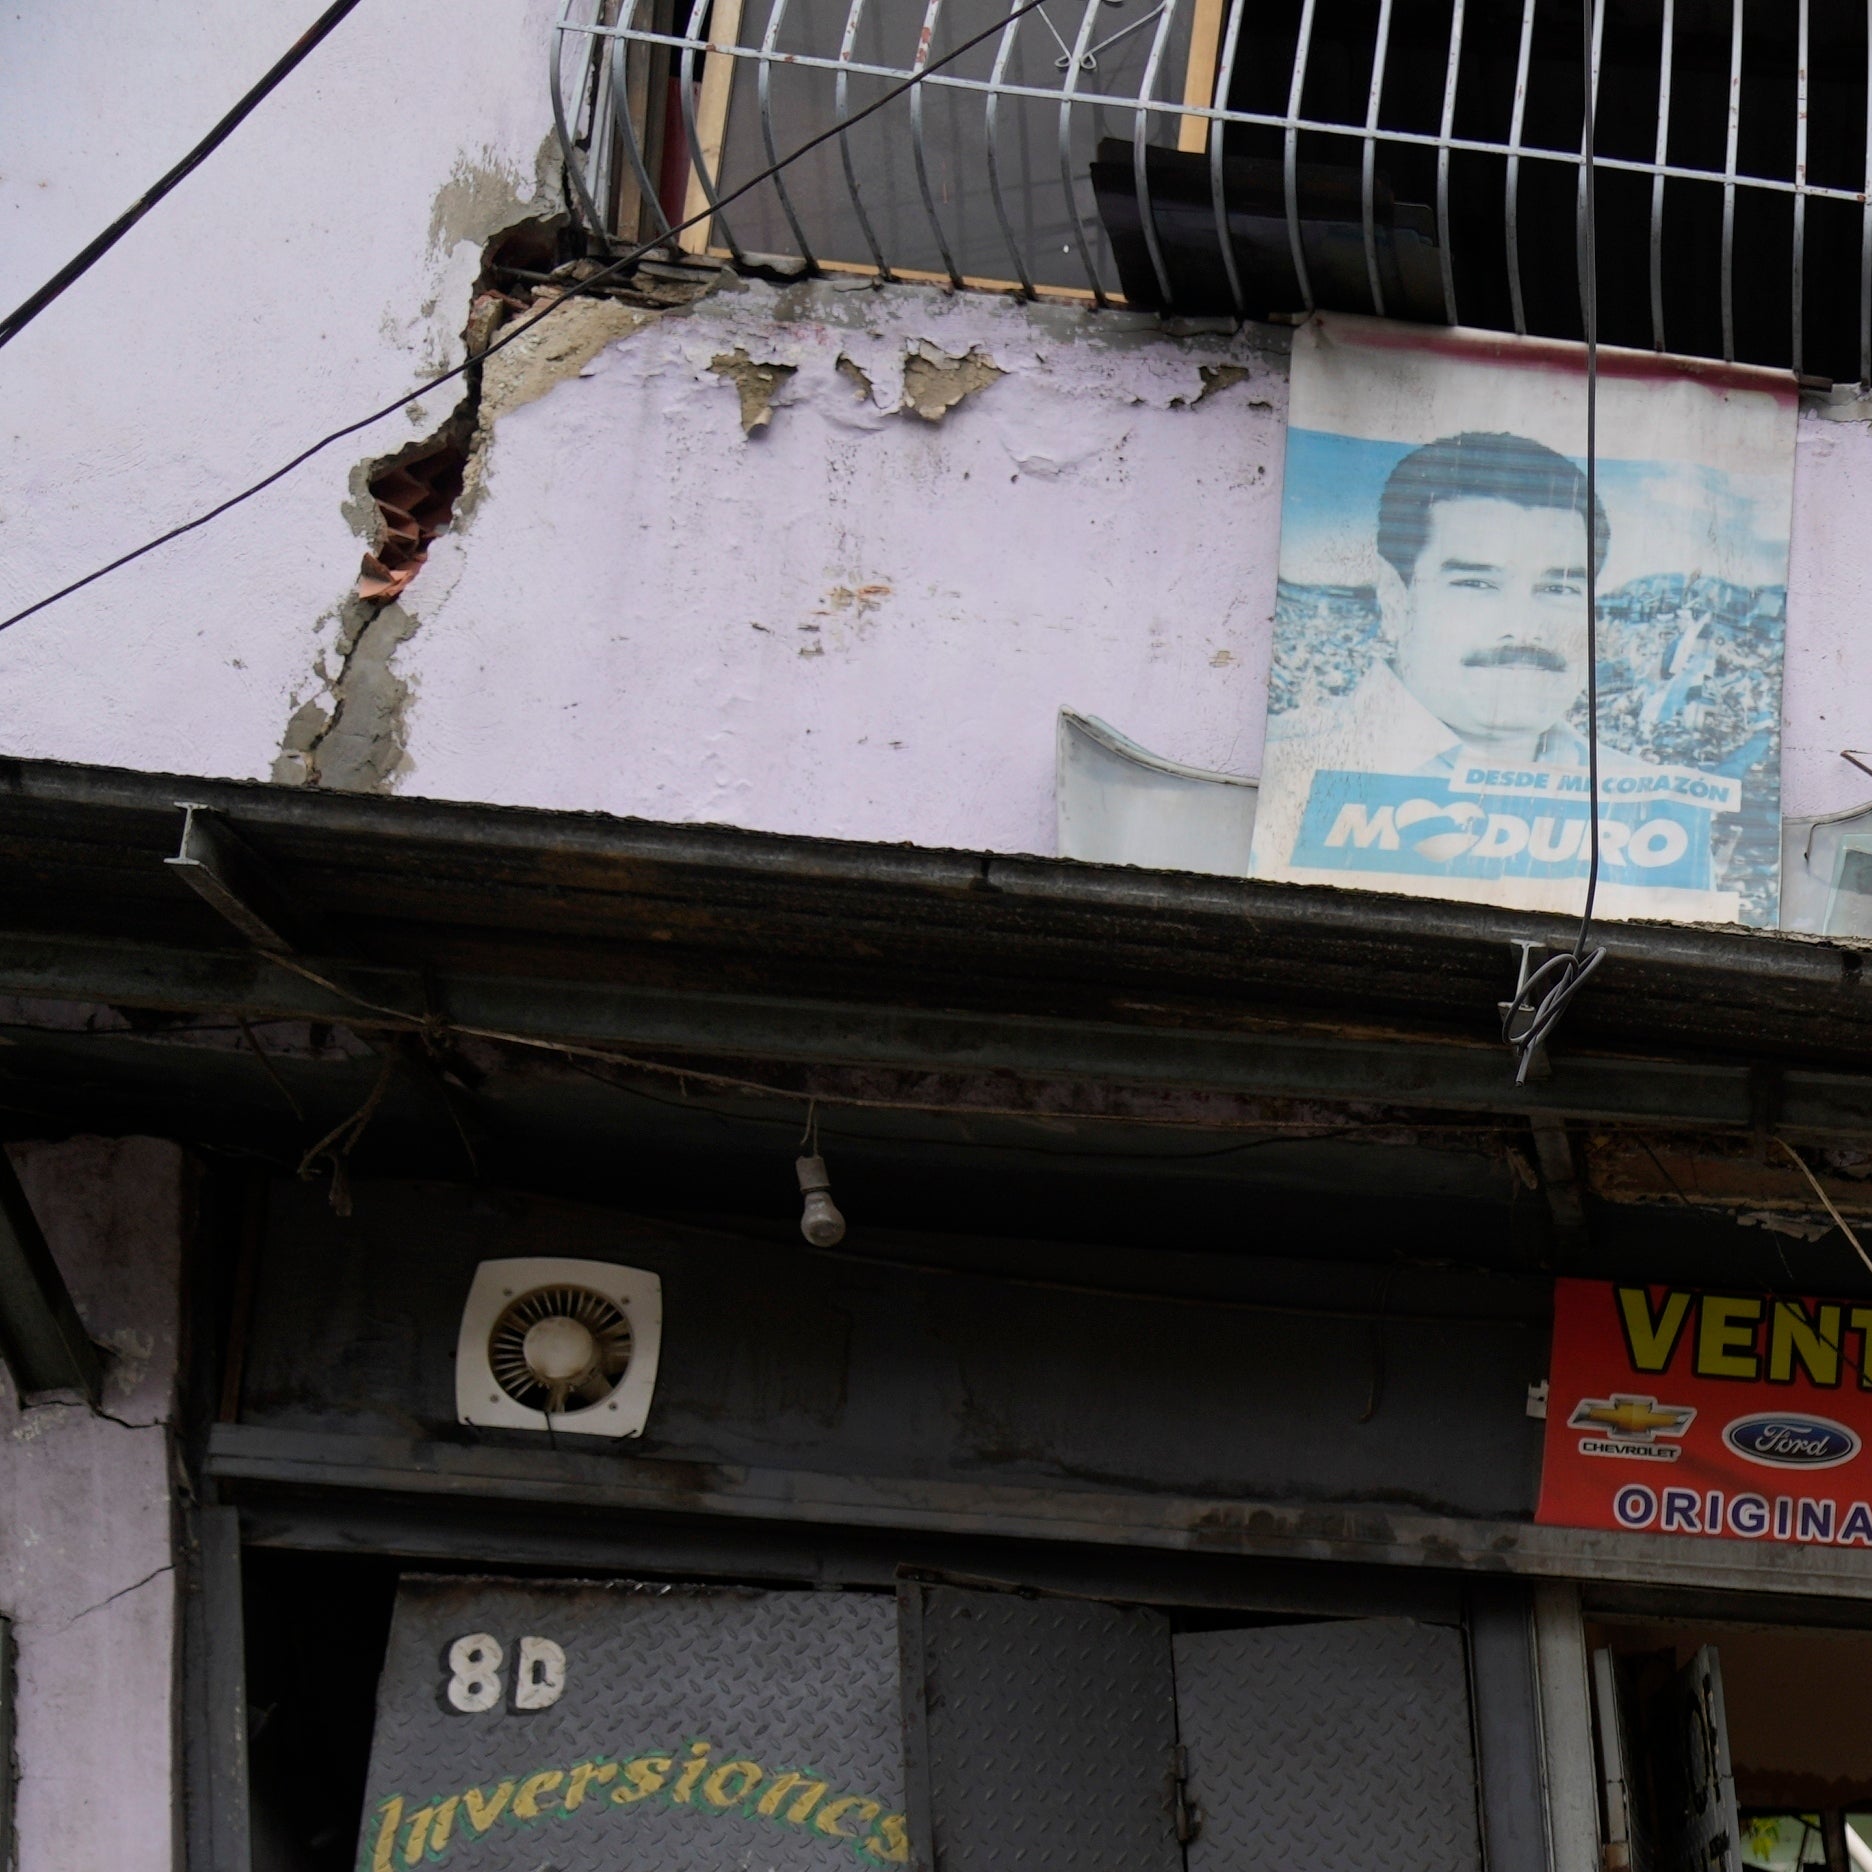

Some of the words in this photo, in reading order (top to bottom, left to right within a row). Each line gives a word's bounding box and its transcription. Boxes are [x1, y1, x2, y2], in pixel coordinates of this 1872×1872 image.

[1465, 768, 1550, 789] DESDE
[1600, 774, 1731, 804] CORAZÓN
[1581, 1440, 1678, 1461] CHEVROLET
[1753, 1424, 1828, 1457] Ford
